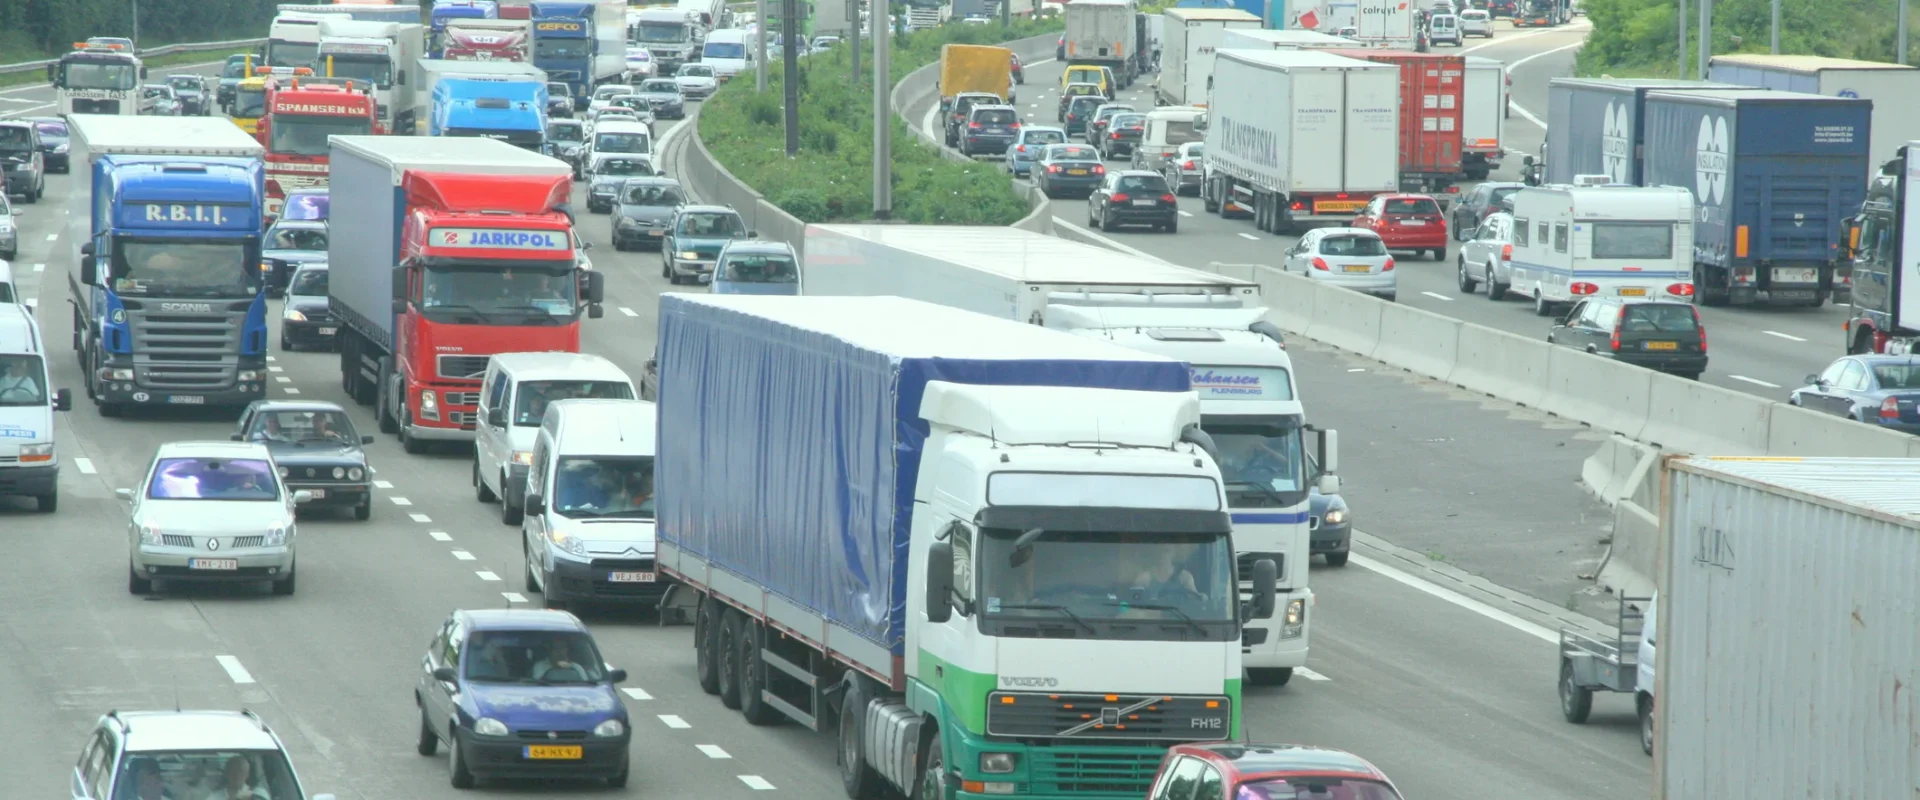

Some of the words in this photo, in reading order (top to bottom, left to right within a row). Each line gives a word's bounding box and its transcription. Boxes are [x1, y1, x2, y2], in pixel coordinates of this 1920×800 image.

[1363, 5, 1396, 16] colruyt
[537, 23, 580, 31] GEFCO
[276, 103, 346, 113] SPAANSEN
[1221, 115, 1278, 169] TRANSPRISMA
[469, 232, 555, 247] JARKPOL
[161, 303, 211, 312] SCANIA
[1211, 387, 1262, 395] FLENSBURG
[196, 560, 235, 568] XMX-218
[1001, 676, 1059, 687] VOLVO
[1191, 718, 1221, 728] FH12
